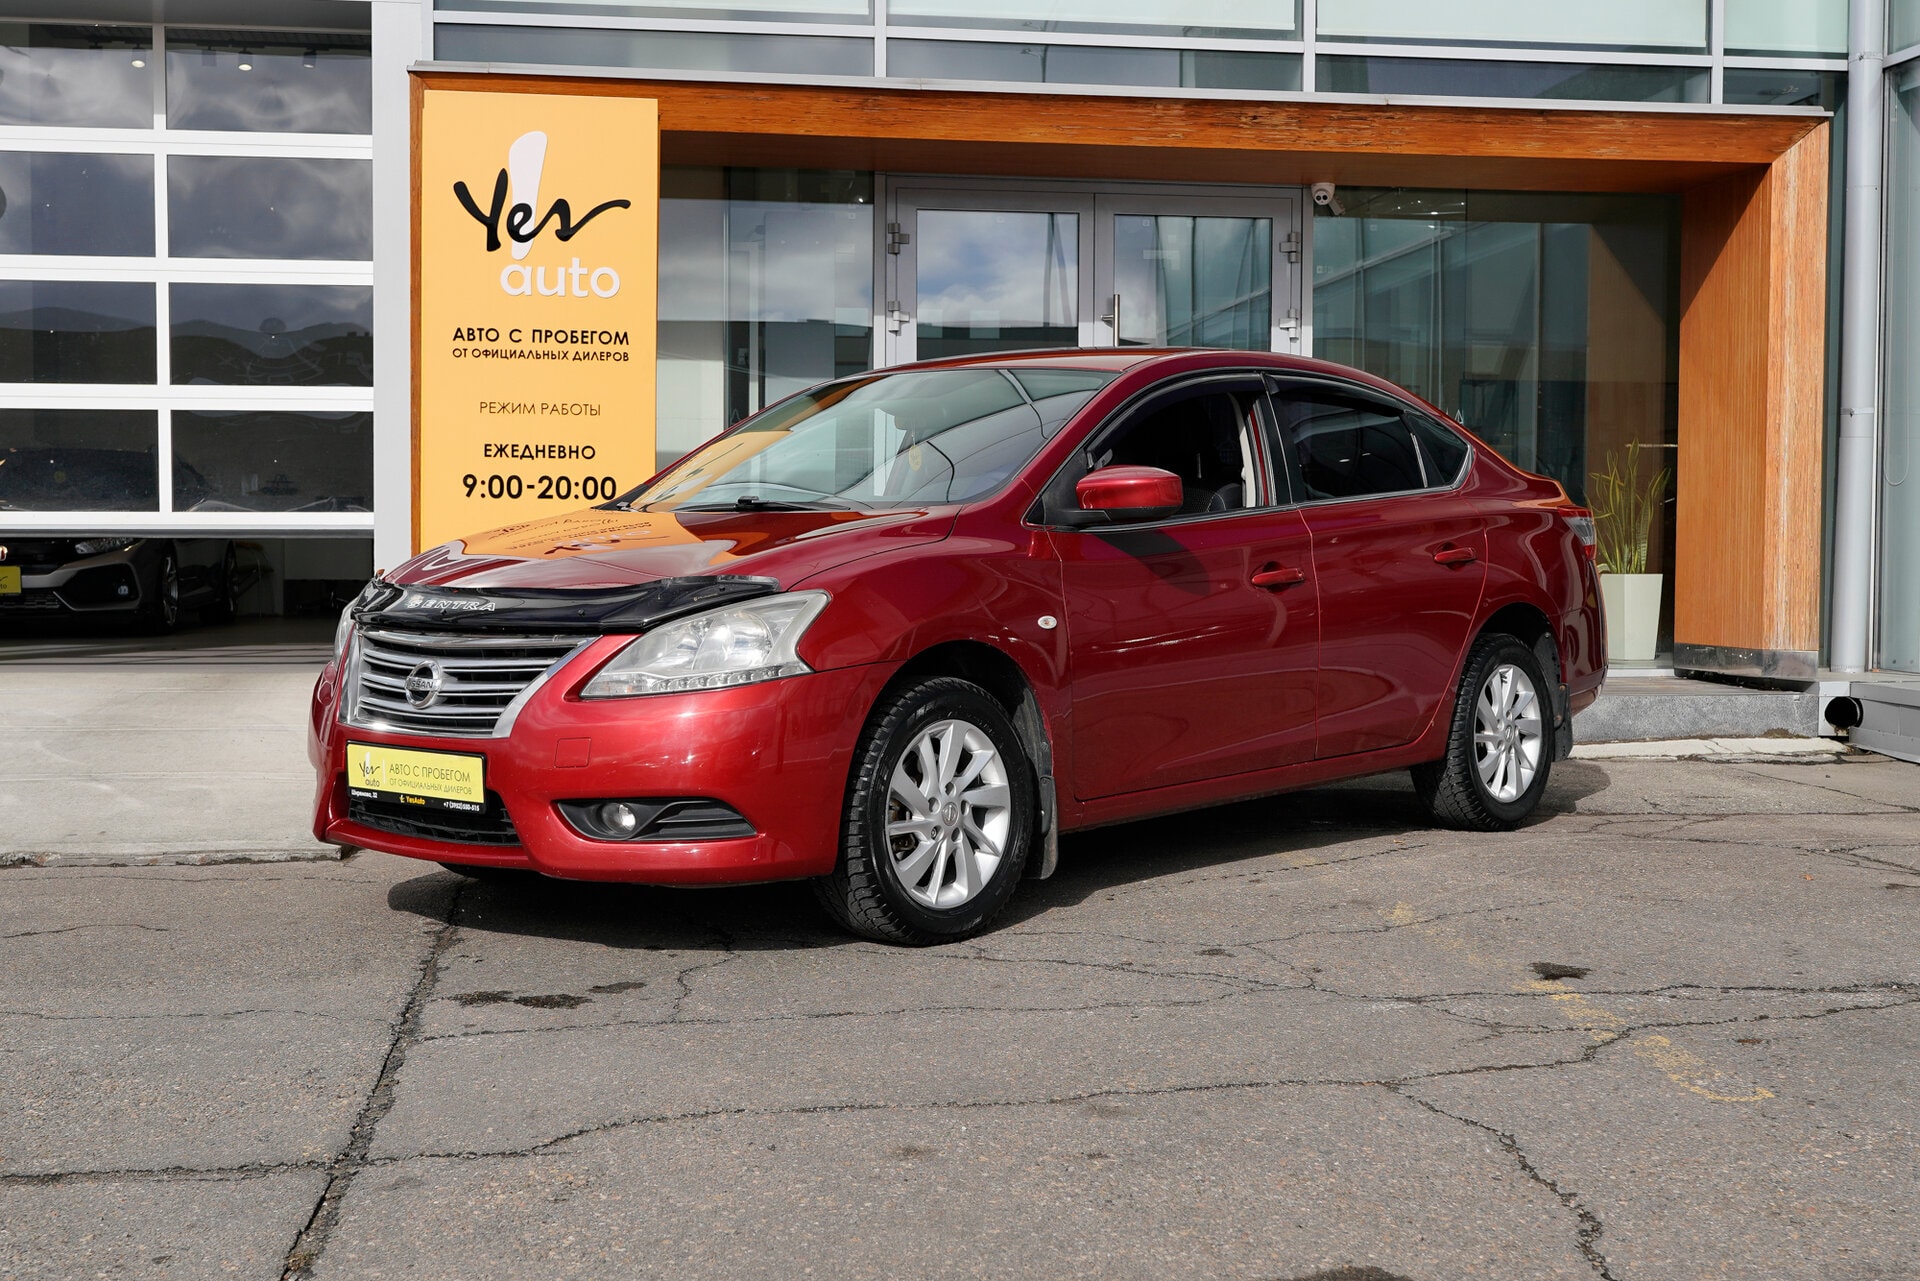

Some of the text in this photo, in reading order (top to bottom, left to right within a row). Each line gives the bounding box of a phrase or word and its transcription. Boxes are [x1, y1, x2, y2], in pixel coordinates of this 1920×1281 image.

[453, 168, 631, 252] Yes
[500, 257, 620, 298] auto
[453, 327, 629, 345] АВТО С ПРОБЕГОМ
[452, 348, 629, 362] ОТ ОФИЦИАЛЬНЫХ ДИЛЕРОВ
[479, 401, 601, 416] РЕЖИМ РАБОТЫ
[483, 444, 596, 460] ЕЖЕДНЕВНО
[462, 473, 617, 500] 9:00-20:00
[390, 764, 471, 782] АВТО С ПРОБЕГОМ
[365, 778, 380, 787] auto
